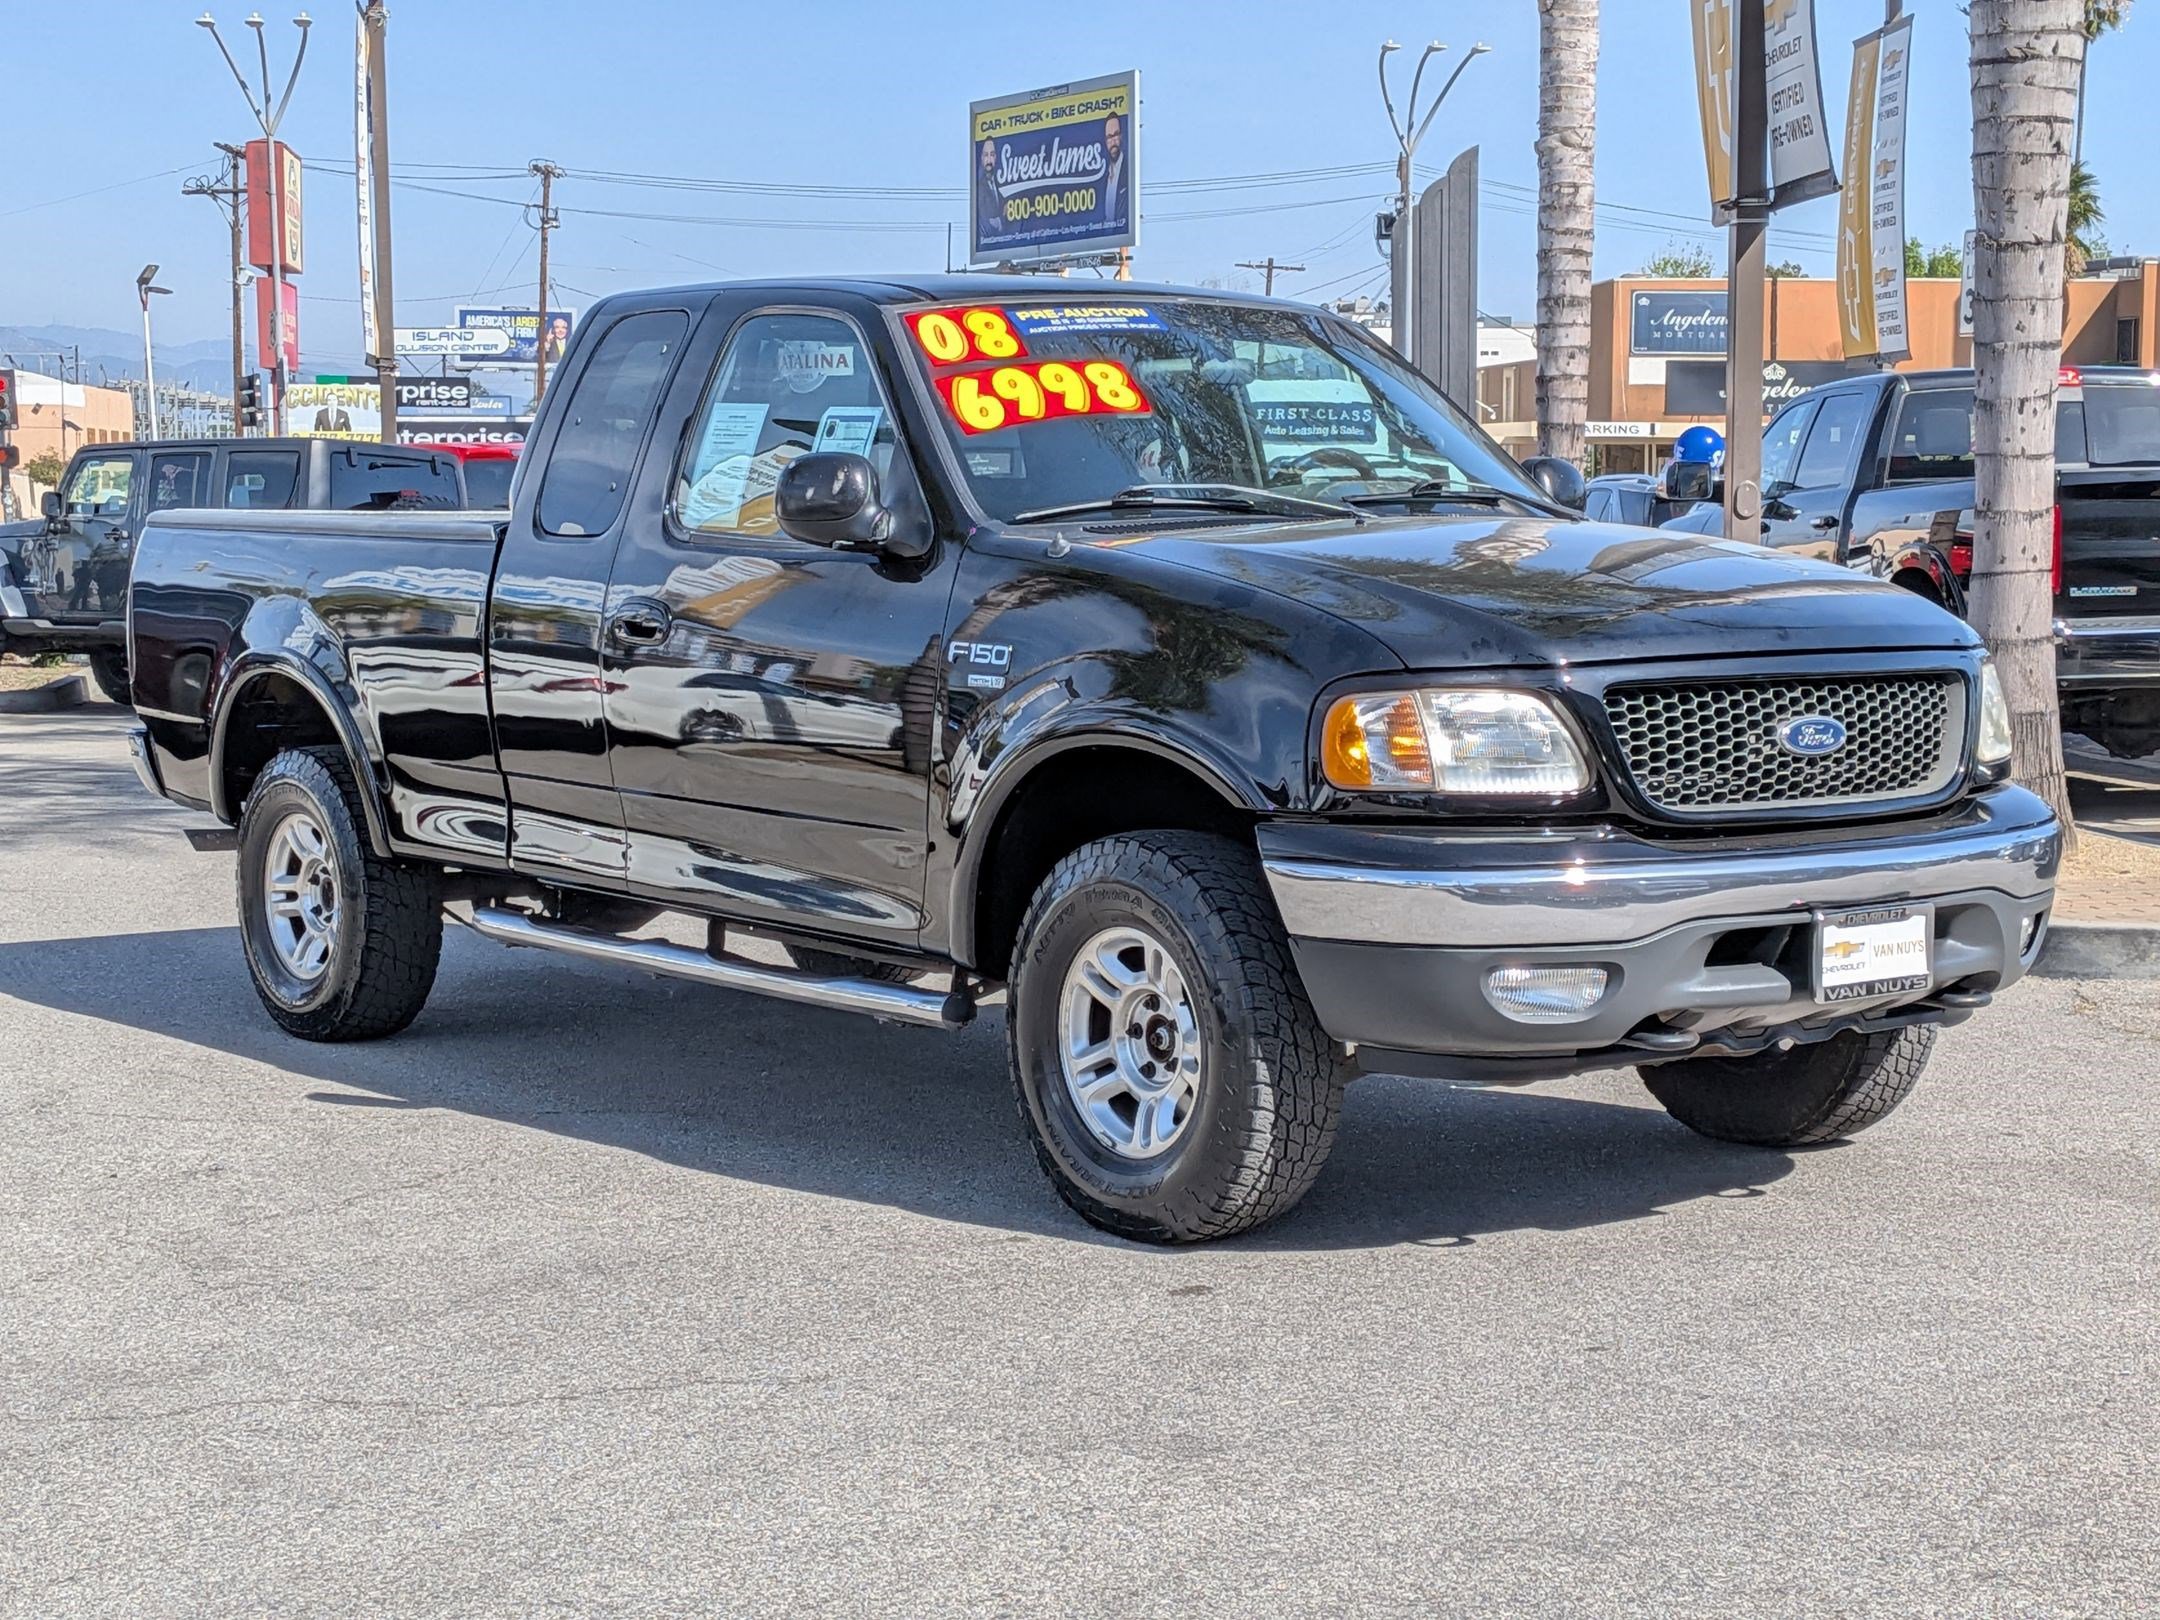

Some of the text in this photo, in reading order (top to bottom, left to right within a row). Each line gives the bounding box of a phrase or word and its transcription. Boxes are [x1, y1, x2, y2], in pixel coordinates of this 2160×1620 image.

[1764, 36, 1802, 69] CHEVROLET
[980, 95, 1125, 133] CAR TRUCK BIKE CRASH?
[997, 137, 1106, 184] Sweet James
[1007, 187, 1096, 222] 800-900-0000
[466, 315, 541, 328] AMERICA'S LARGE
[1016, 307, 1149, 321] PRE-AUCTION
[1650, 309, 1728, 331] Angelen
[412, 331, 475, 342] ISLAND
[917, 309, 1019, 362] 08
[1652, 331, 1727, 339] MORTUAR
[395, 343, 448, 352] OLLISION
[451, 343, 499, 352] CENTER
[783, 353, 850, 369] ATALINA
[395, 381, 469, 404] prise
[952, 362, 1141, 430] 6998
[1256, 407, 1373, 422] FIRST CLASS
[396, 427, 524, 444] terprise
[1264, 424, 1287, 435] Auto
[1289, 425, 1329, 437] Leasing
[1330, 424, 1339, 435] &
[1584, 424, 1641, 435] ARKING
[1797, 724, 1835, 746] Ford
[1847, 908, 1905, 925] CHEVROLET
[1873, 940, 1925, 958] VAN NUYS
[1822, 961, 1866, 974] CHEVROLET
[1826, 975, 1927, 1001] VAN NUYS
